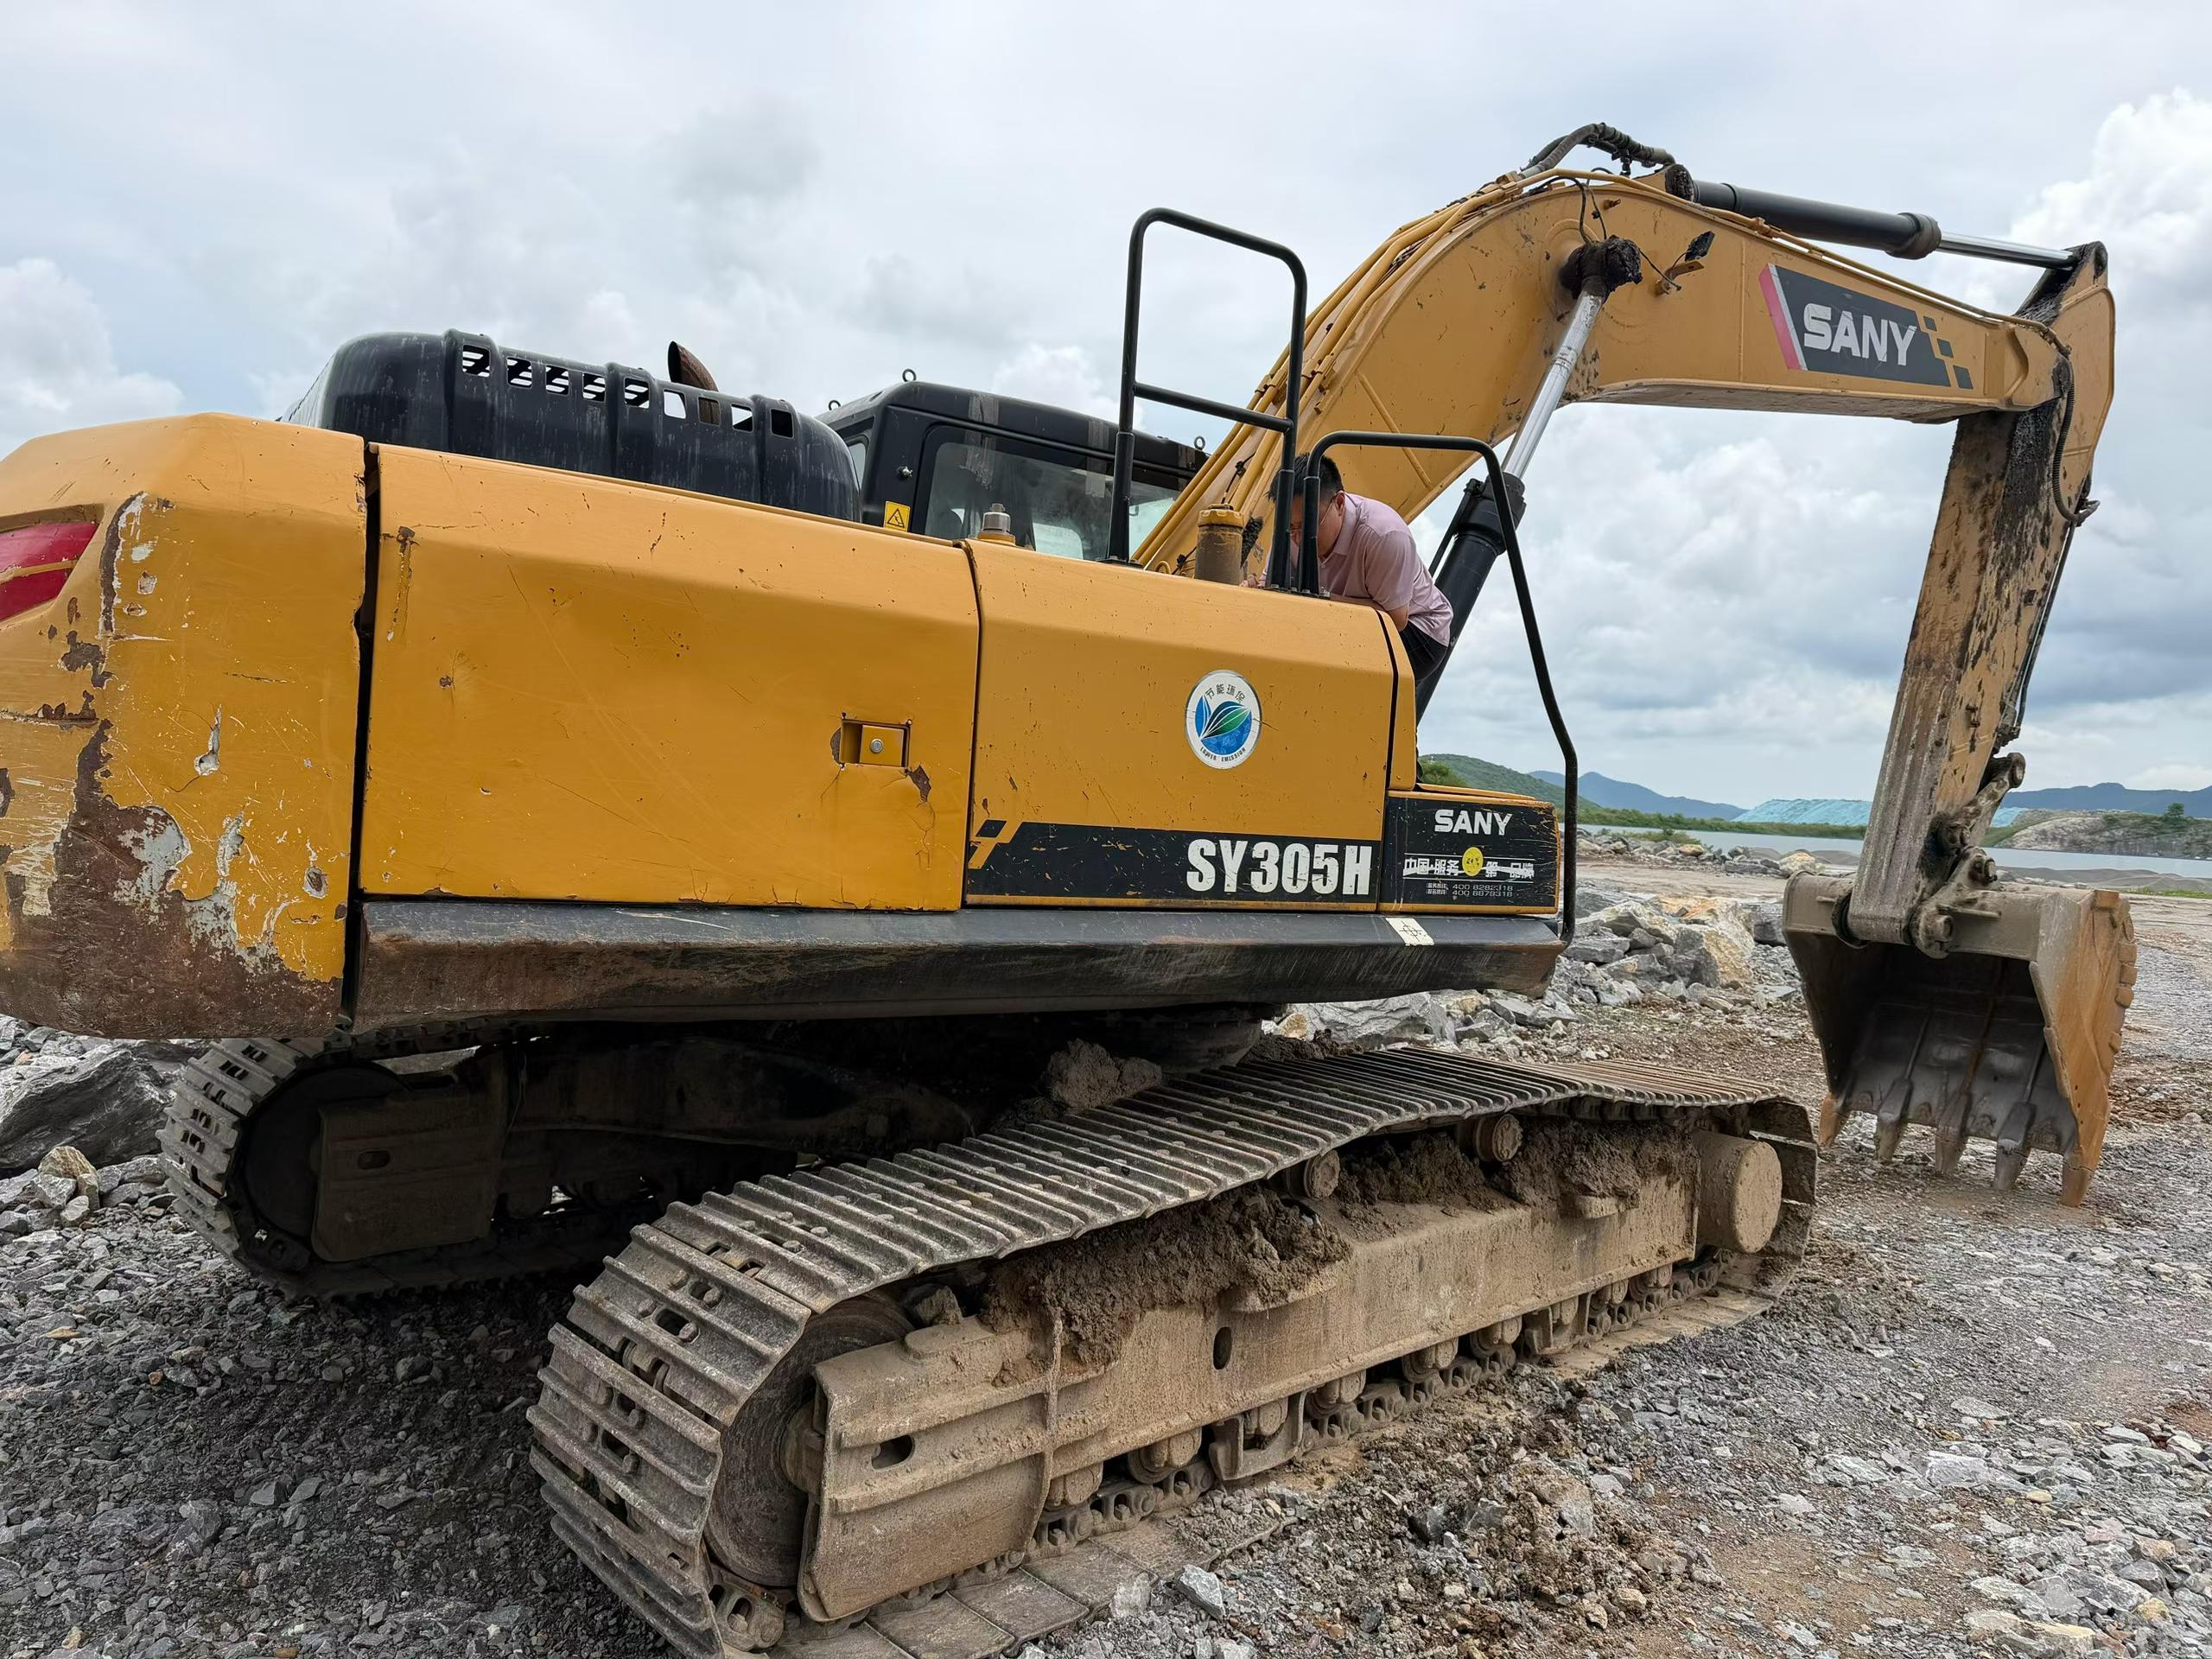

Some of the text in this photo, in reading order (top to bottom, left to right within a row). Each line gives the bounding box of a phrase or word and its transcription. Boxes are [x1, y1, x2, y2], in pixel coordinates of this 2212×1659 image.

[1803, 302, 1917, 366] SANY
[1434, 809, 1514, 836] SANY
[1185, 838, 1373, 895] SY305H
